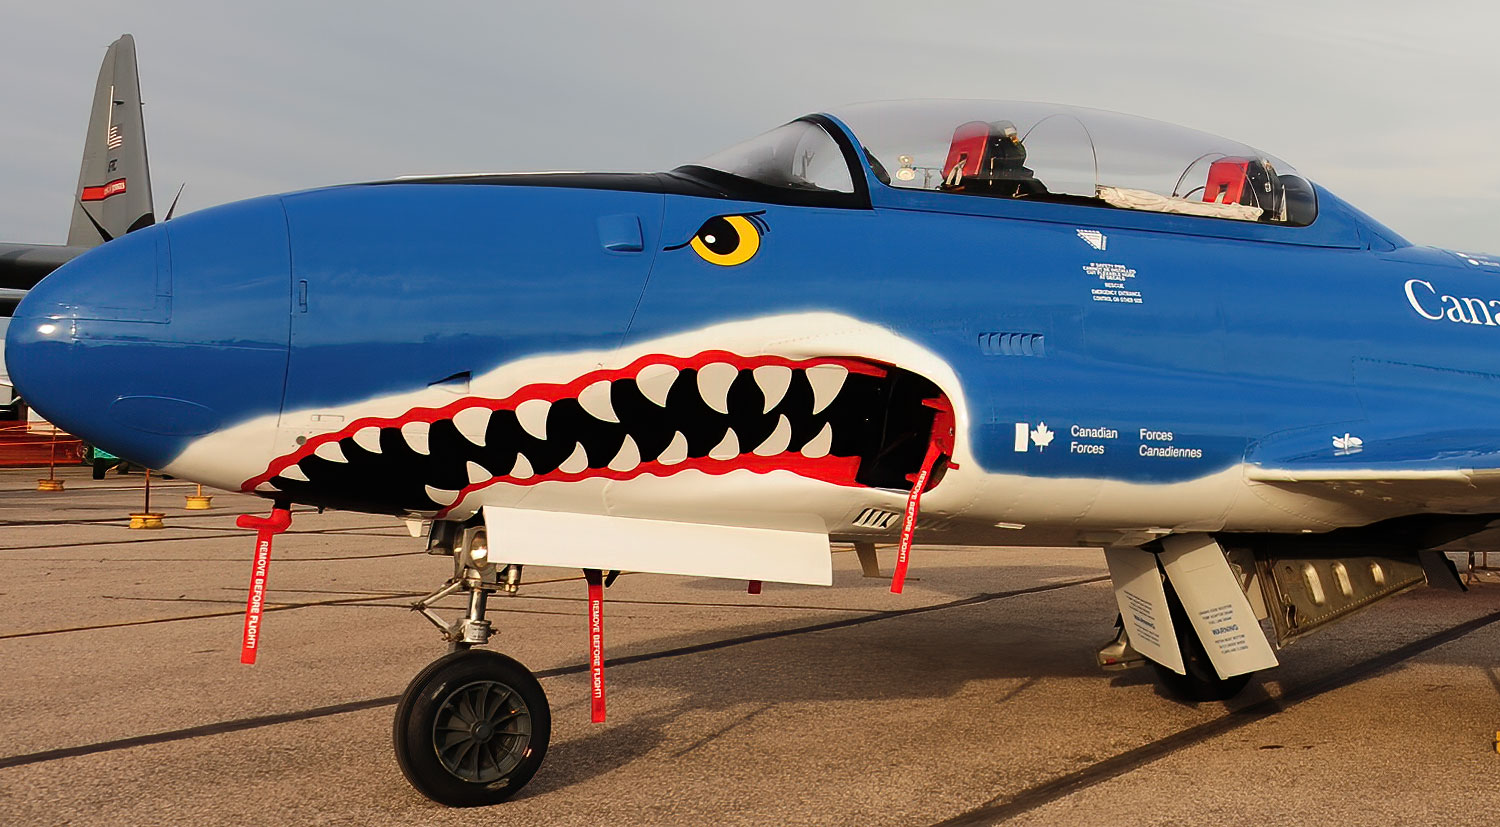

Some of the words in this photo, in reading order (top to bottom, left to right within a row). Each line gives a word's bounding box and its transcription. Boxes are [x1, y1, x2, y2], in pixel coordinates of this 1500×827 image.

[1070, 425, 1118, 439] Canadian
[1139, 428, 1173, 441] Forces
[1070, 441, 1105, 454] Forces
[1139, 444, 1203, 458] Canadiennes
[911, 470, 927, 500] REMOVE
[904, 501, 916, 532] BEFORE
[256, 540, 269, 577] REMOVE
[899, 533, 910, 563] FLIGHT
[250, 578, 264, 614] BEFORE
[592, 600, 600, 633] REMOVE
[1211, 624, 1239, 635] WARNING
[245, 615, 259, 649] FLIGHT
[593, 634, 601, 666] BEFORE
[594, 667, 602, 699] FLIGHT
